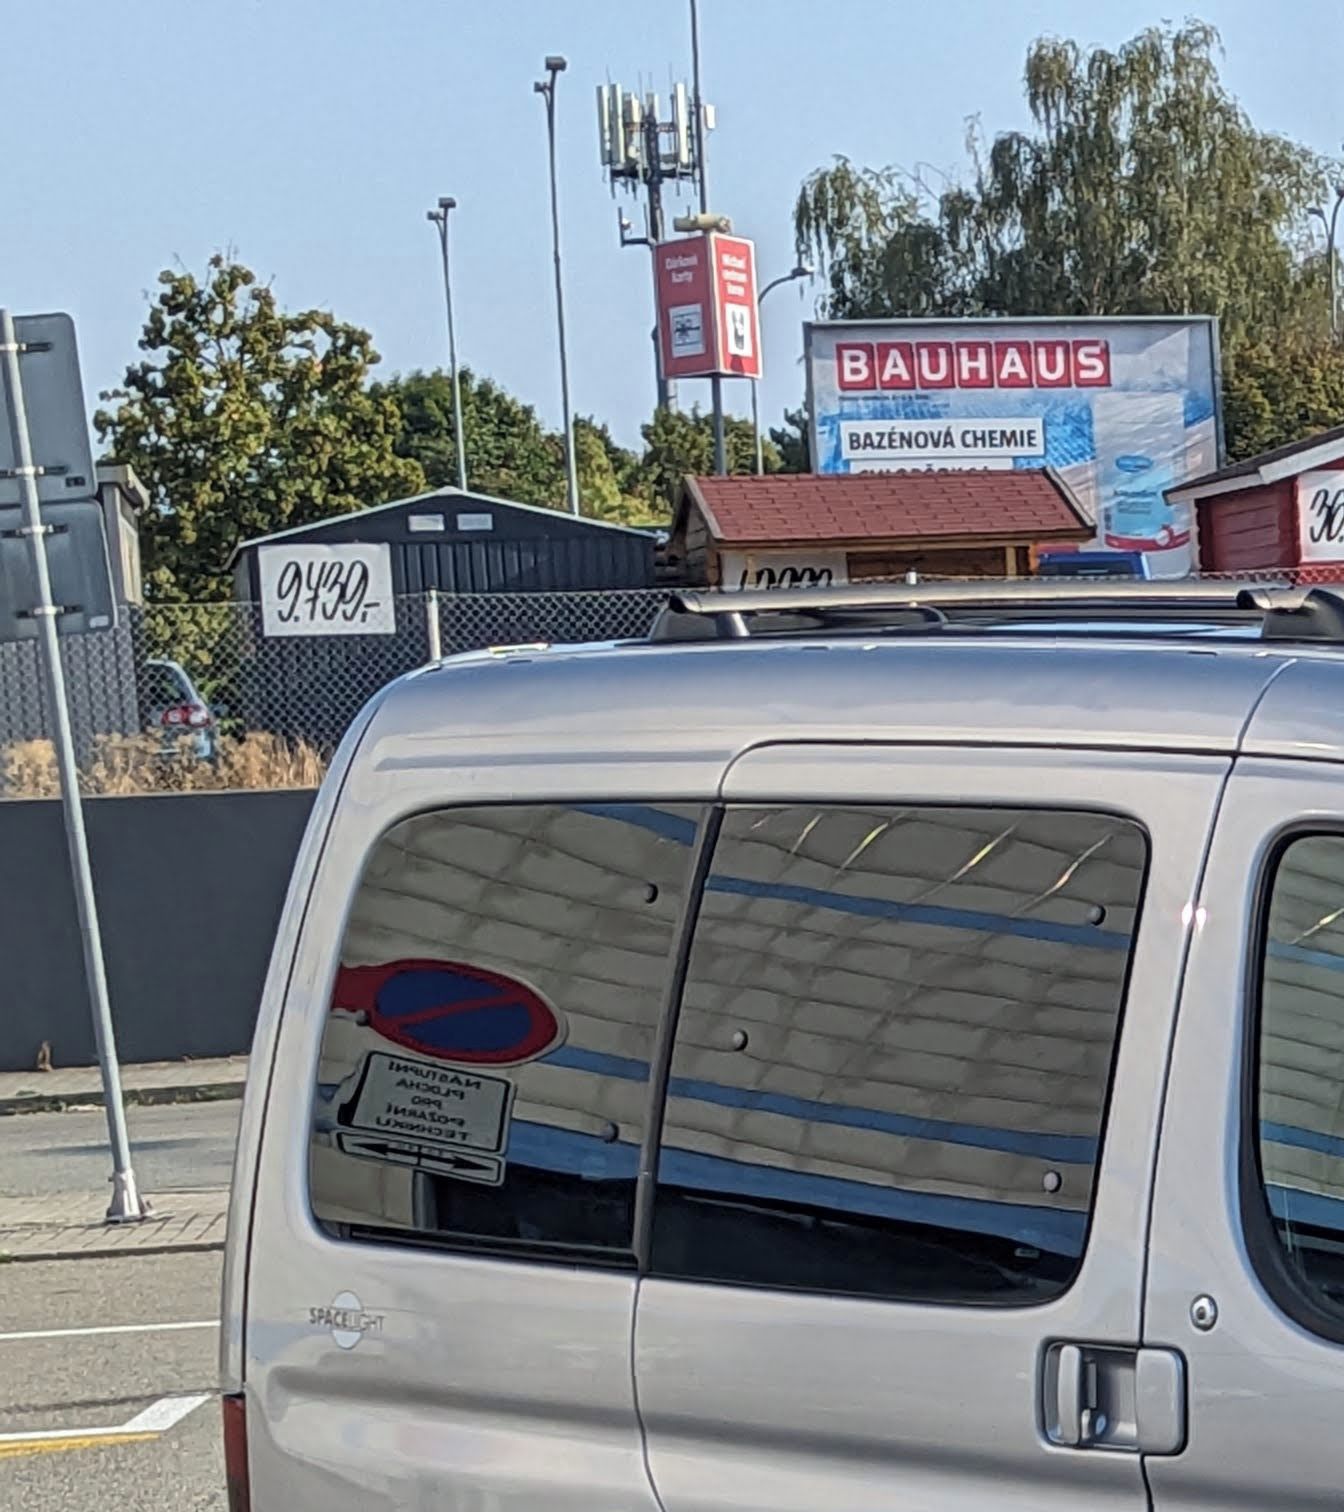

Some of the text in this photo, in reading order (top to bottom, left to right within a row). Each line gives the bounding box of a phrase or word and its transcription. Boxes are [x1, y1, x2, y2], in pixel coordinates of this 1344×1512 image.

[841, 343, 1107, 383] BAUHAUS
[848, 425, 1038, 451] BAZÉNOVÁ CHEMIE
